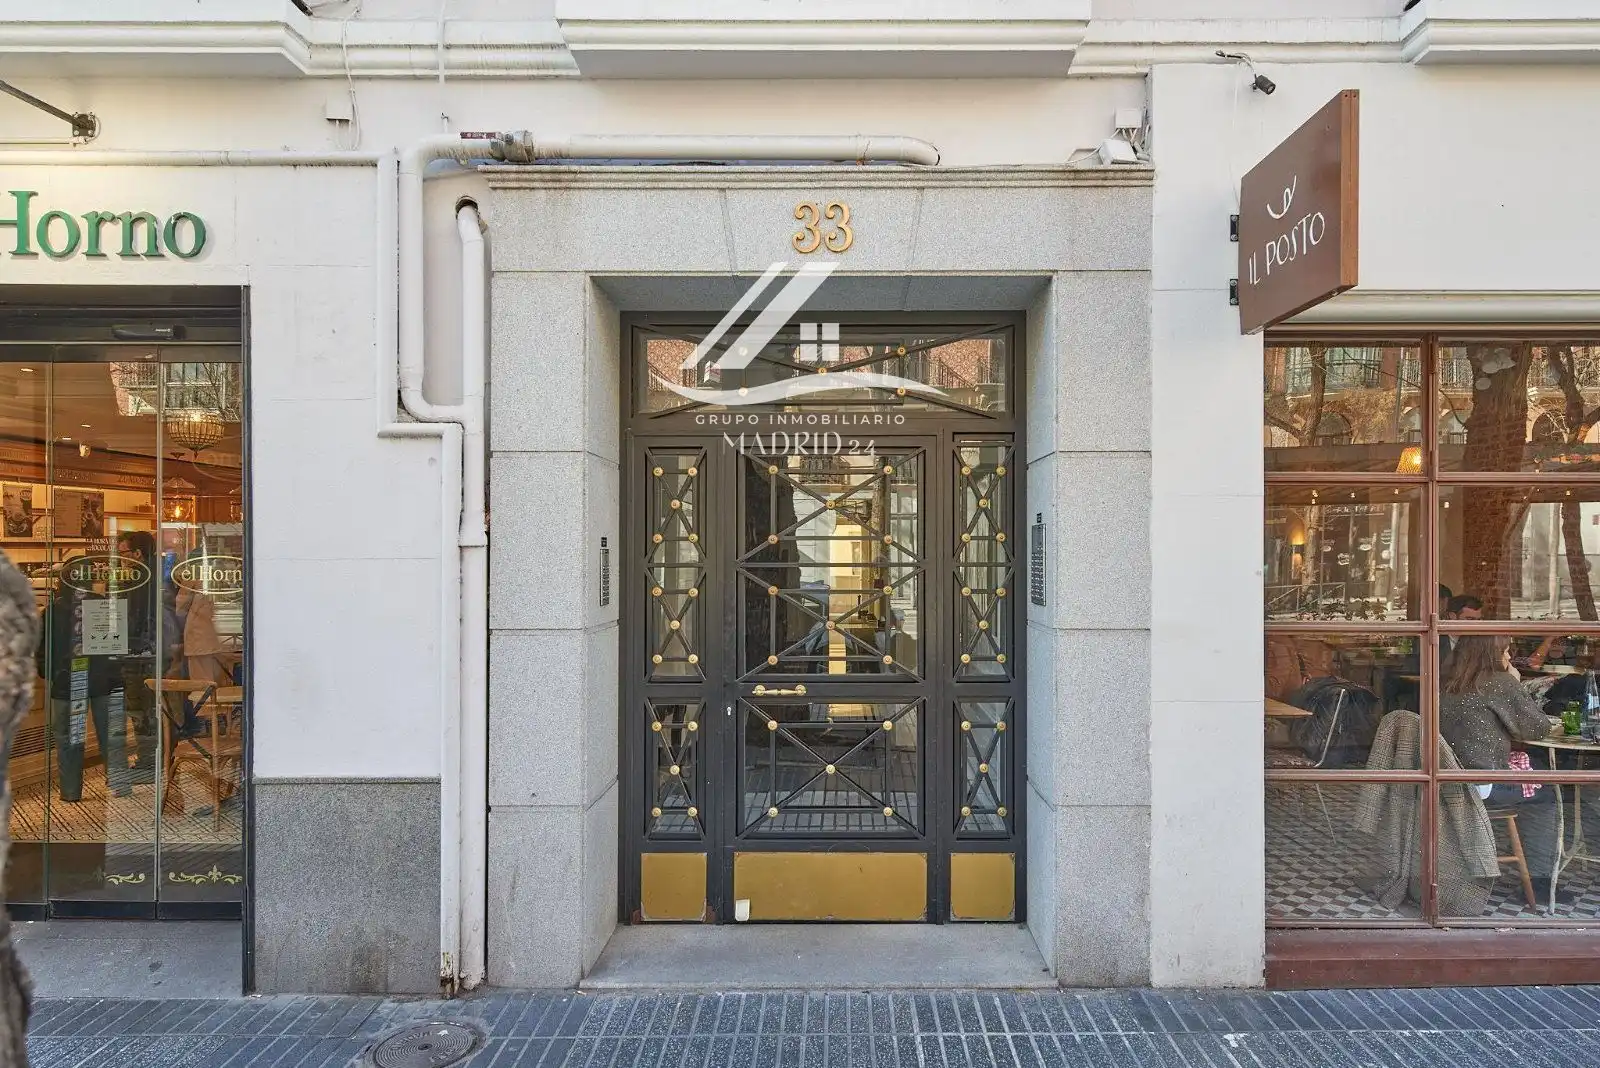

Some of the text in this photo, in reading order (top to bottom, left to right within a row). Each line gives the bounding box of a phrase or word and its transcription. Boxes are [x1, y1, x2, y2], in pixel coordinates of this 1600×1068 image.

[792, 202, 853, 253] 33
[1248, 211, 1325, 285] IL POSTO
